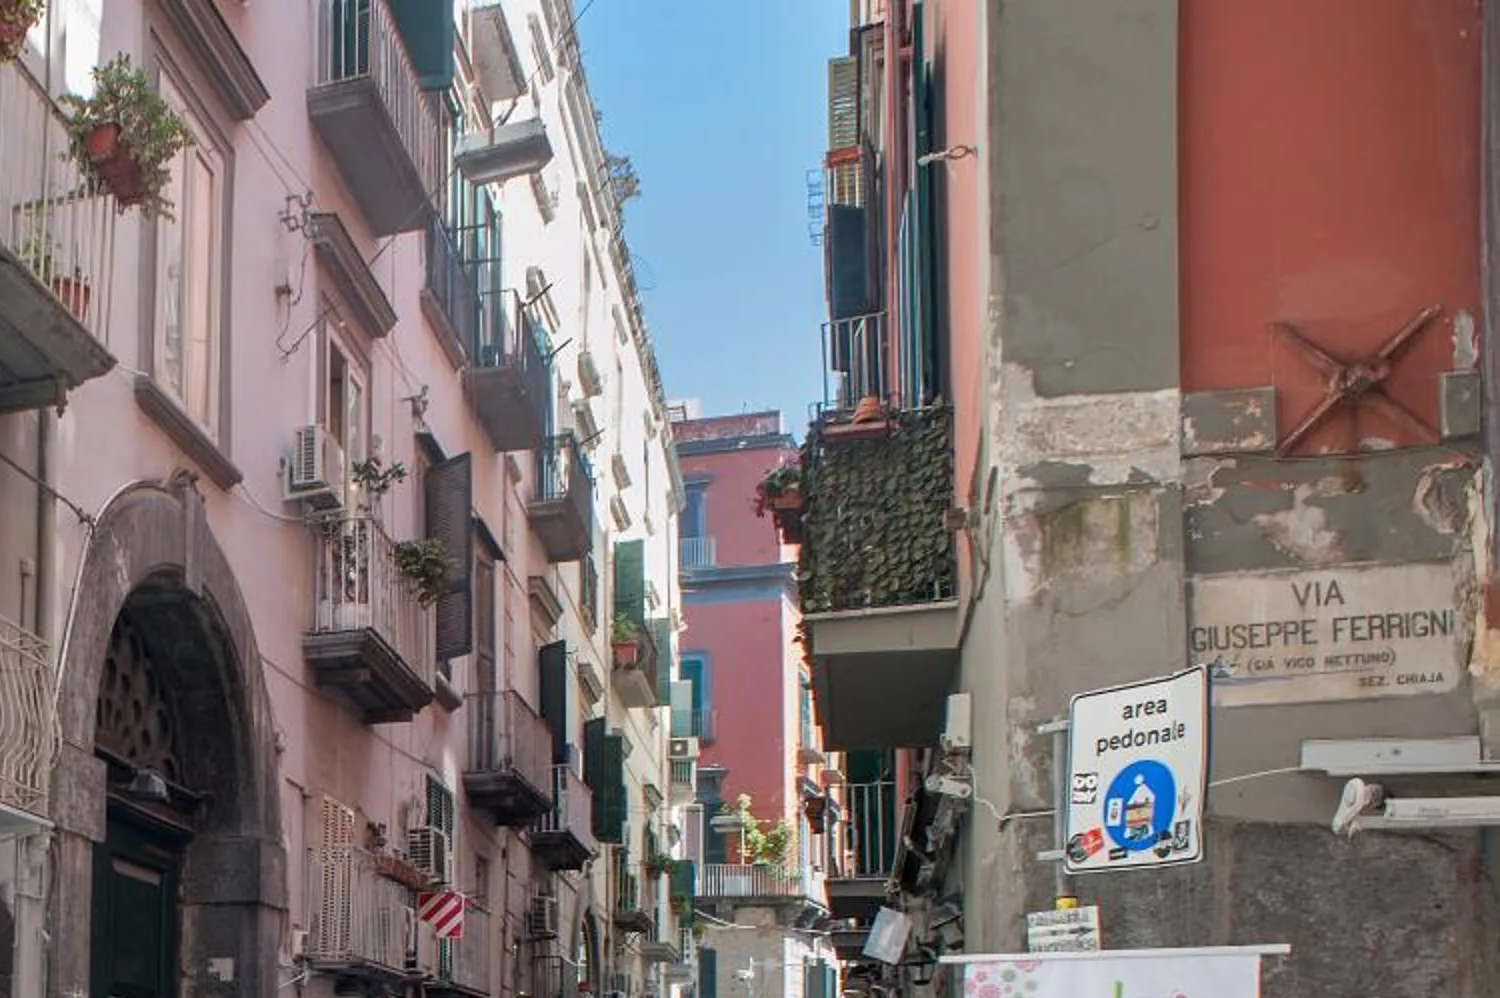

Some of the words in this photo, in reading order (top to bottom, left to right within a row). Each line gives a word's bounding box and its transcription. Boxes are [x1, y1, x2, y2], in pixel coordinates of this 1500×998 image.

[1292, 580, 1344, 608] VIA
[1190, 619, 1318, 652] GIUSEPPE
[1332, 609, 1455, 643] FERRIGNI
[1283, 656, 1315, 669] VICO
[1122, 698, 1168, 720] area
[1096, 722, 1185, 756] pedonale
